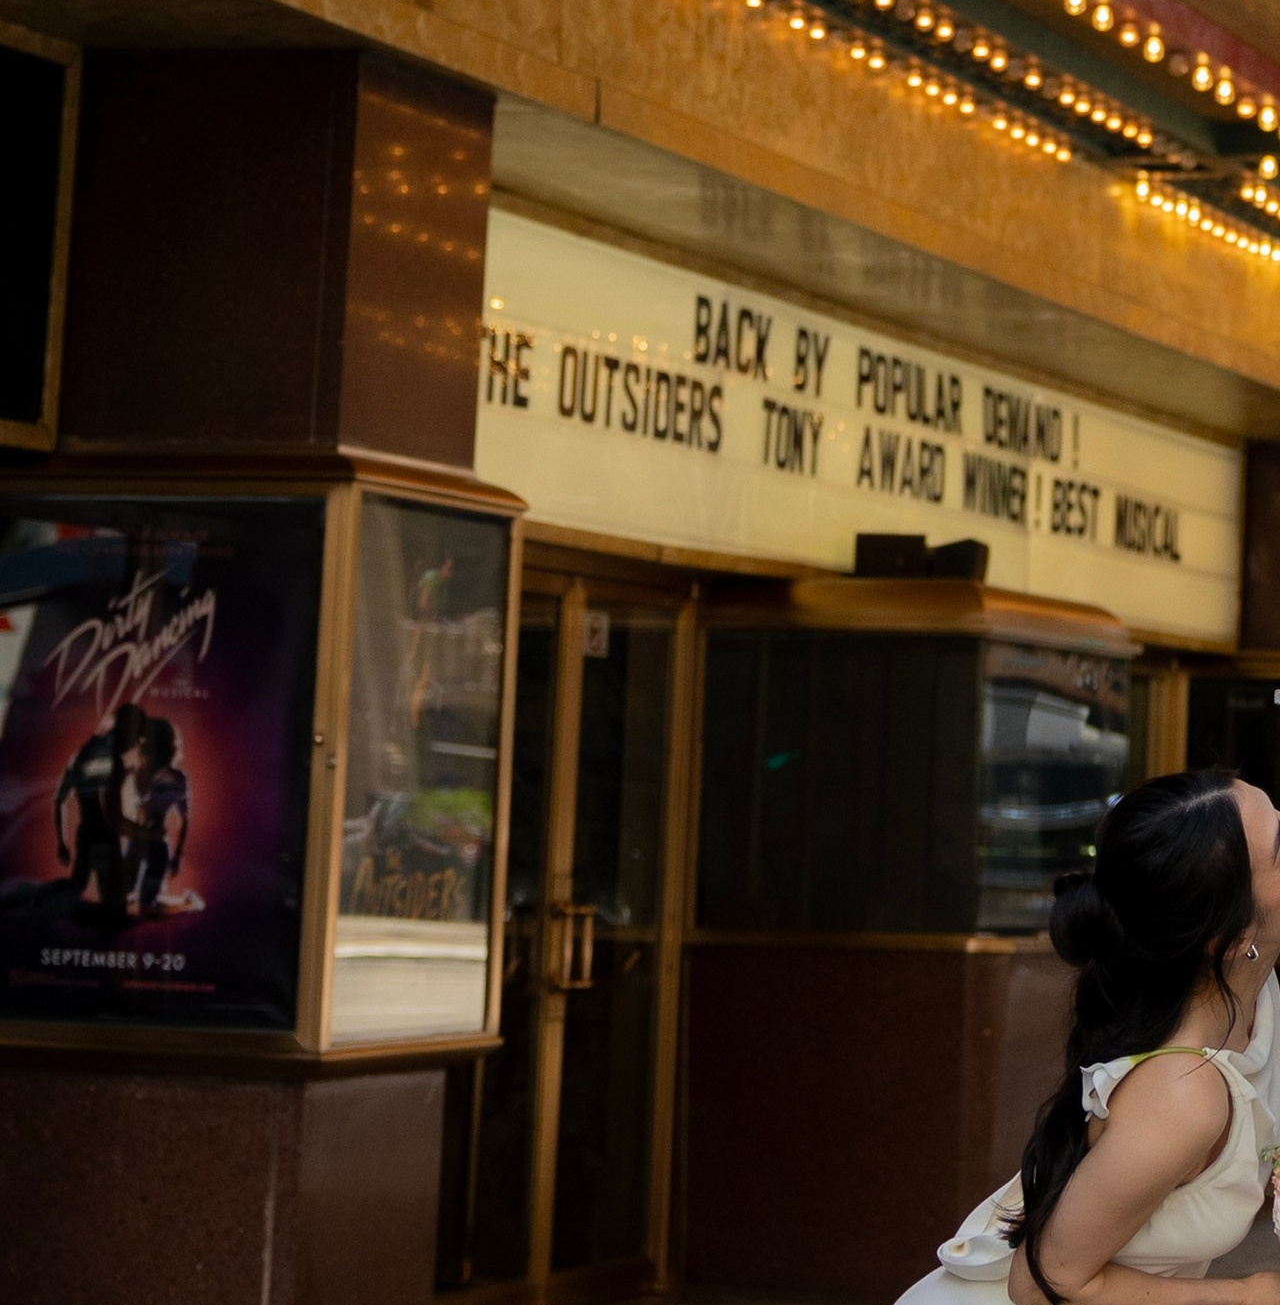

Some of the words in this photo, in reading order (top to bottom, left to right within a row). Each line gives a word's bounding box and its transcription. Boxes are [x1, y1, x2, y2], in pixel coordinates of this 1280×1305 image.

[694, 294, 772, 382] BACK
[794, 326, 830, 397] BY
[855, 346, 963, 436] POPULAR
[480, 328, 534, 409] HE
[558, 346, 724, 454] OUTSIDERS
[763, 397, 824, 477] TONY
[857, 425, 945, 505] AWARD
[1052, 478, 1100, 544] BEST
[1115, 494, 1181, 562] MUSICAL
[42, 564, 174, 711] Dirty
[82, 586, 216, 724] Dancing
[40, 947, 138, 970] SEPTEMBER
[142, 952, 187, 973] 9-20
